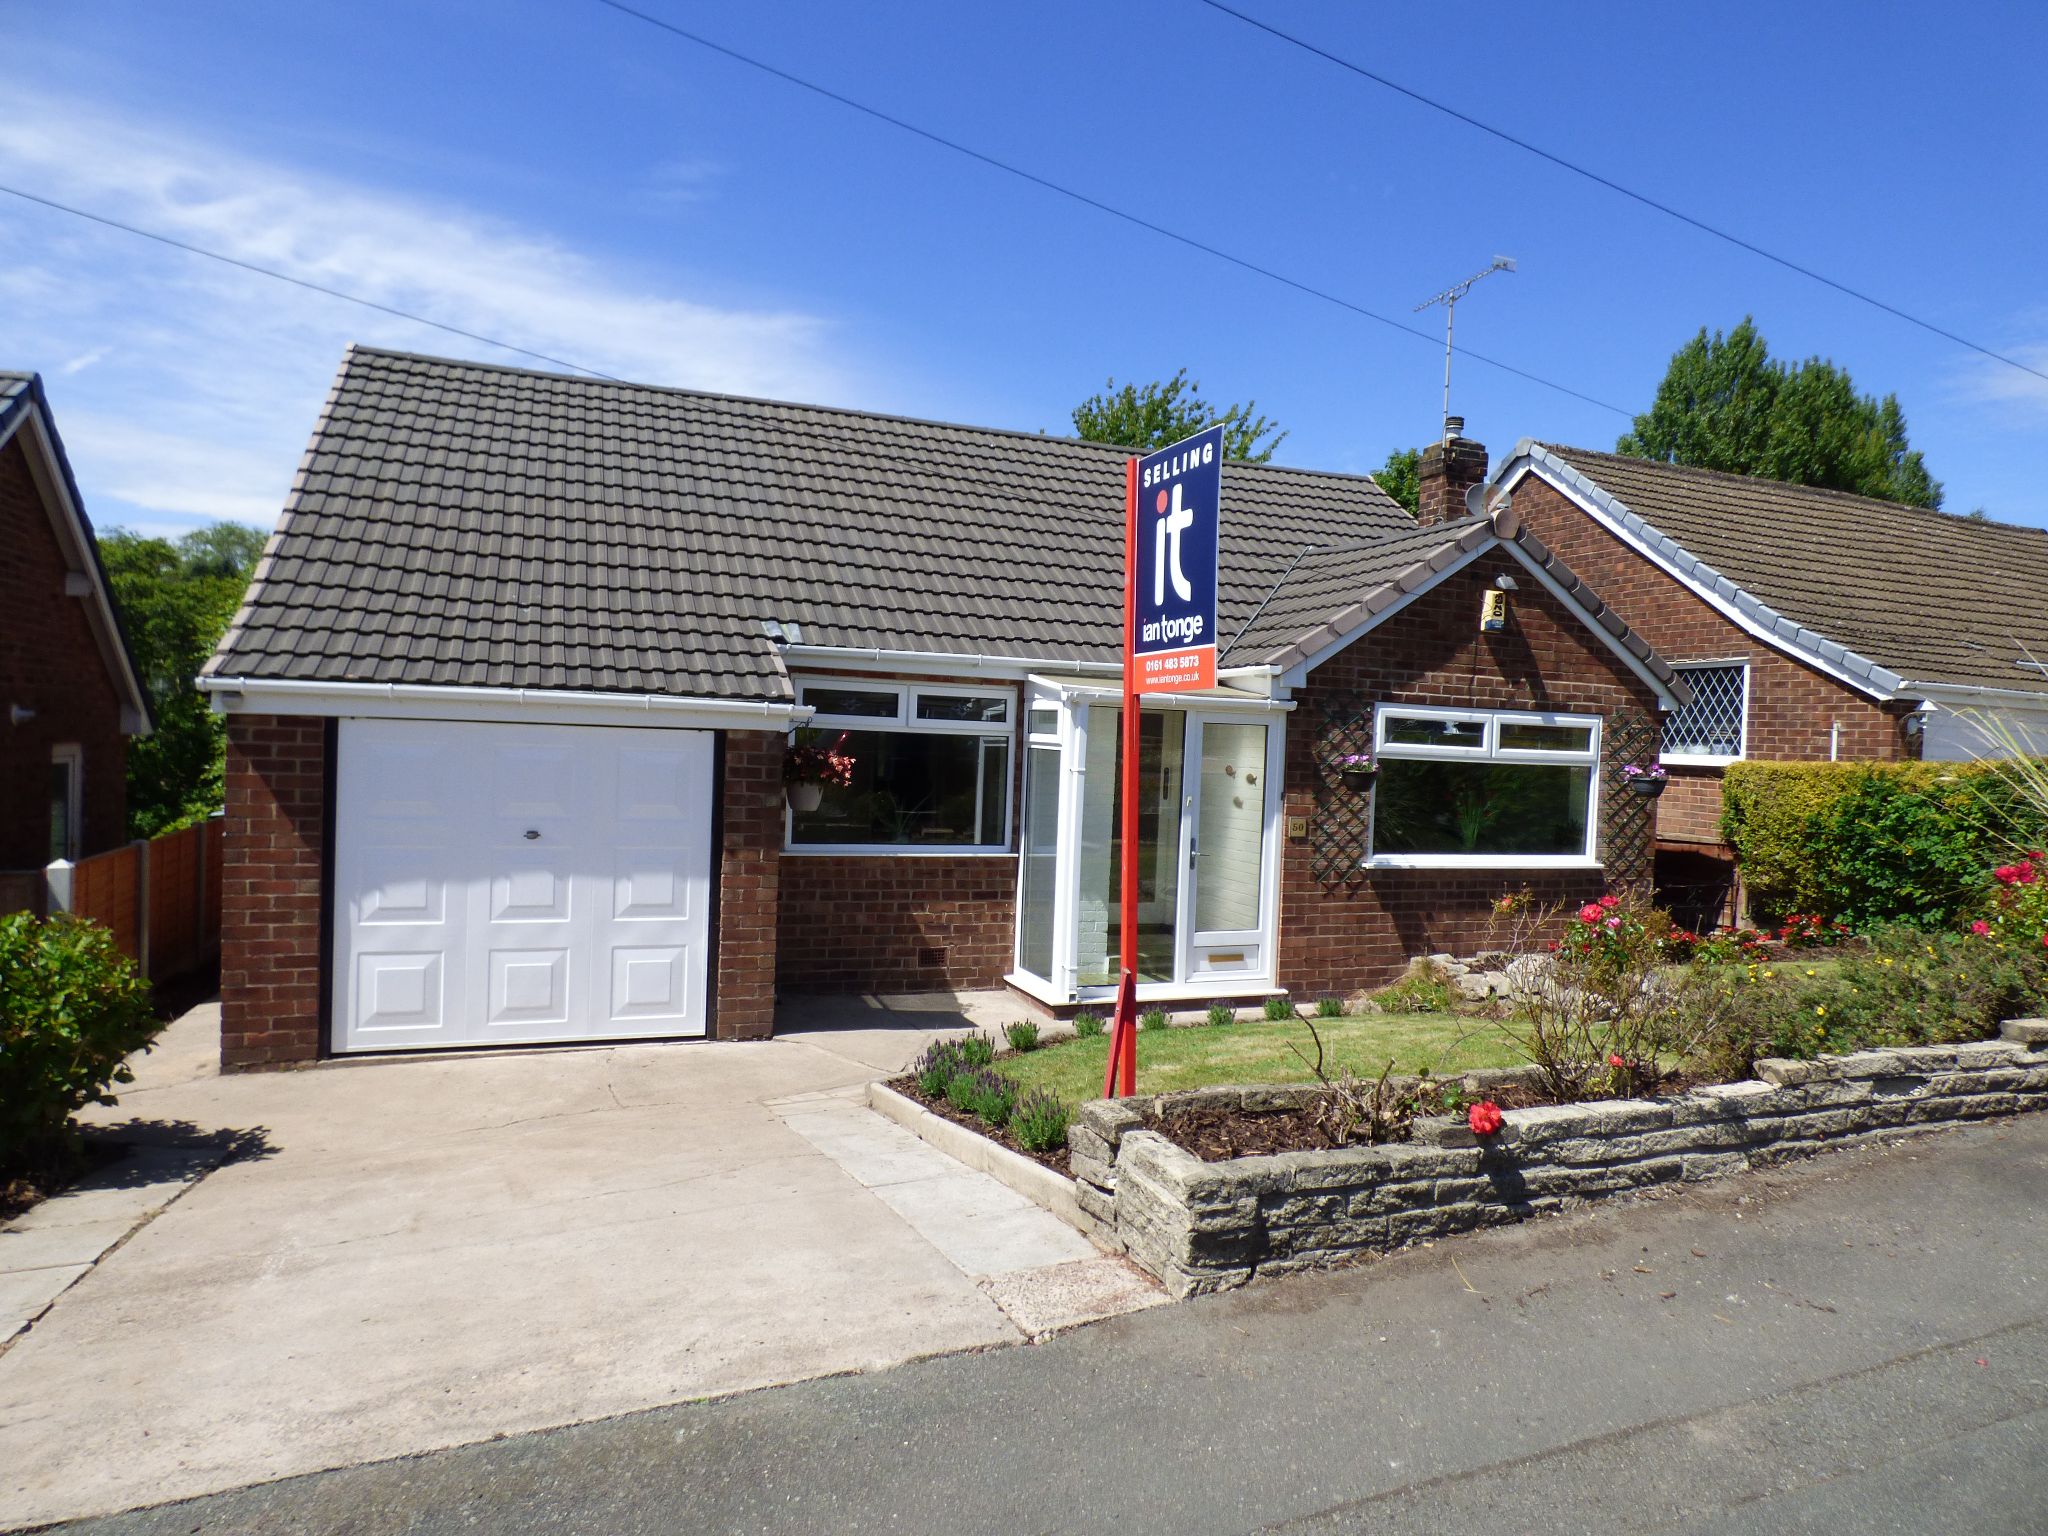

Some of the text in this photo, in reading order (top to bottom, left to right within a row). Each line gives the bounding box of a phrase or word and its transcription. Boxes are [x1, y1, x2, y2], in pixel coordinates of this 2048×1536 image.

[1143, 442, 1213, 488] SELLING
[1154, 483, 1194, 606] it
[1146, 655, 1199, 672] 0161 483 5873
[1145, 671, 1200, 685] www.iantonge.co.uk
[1292, 823, 1304, 832] 50
